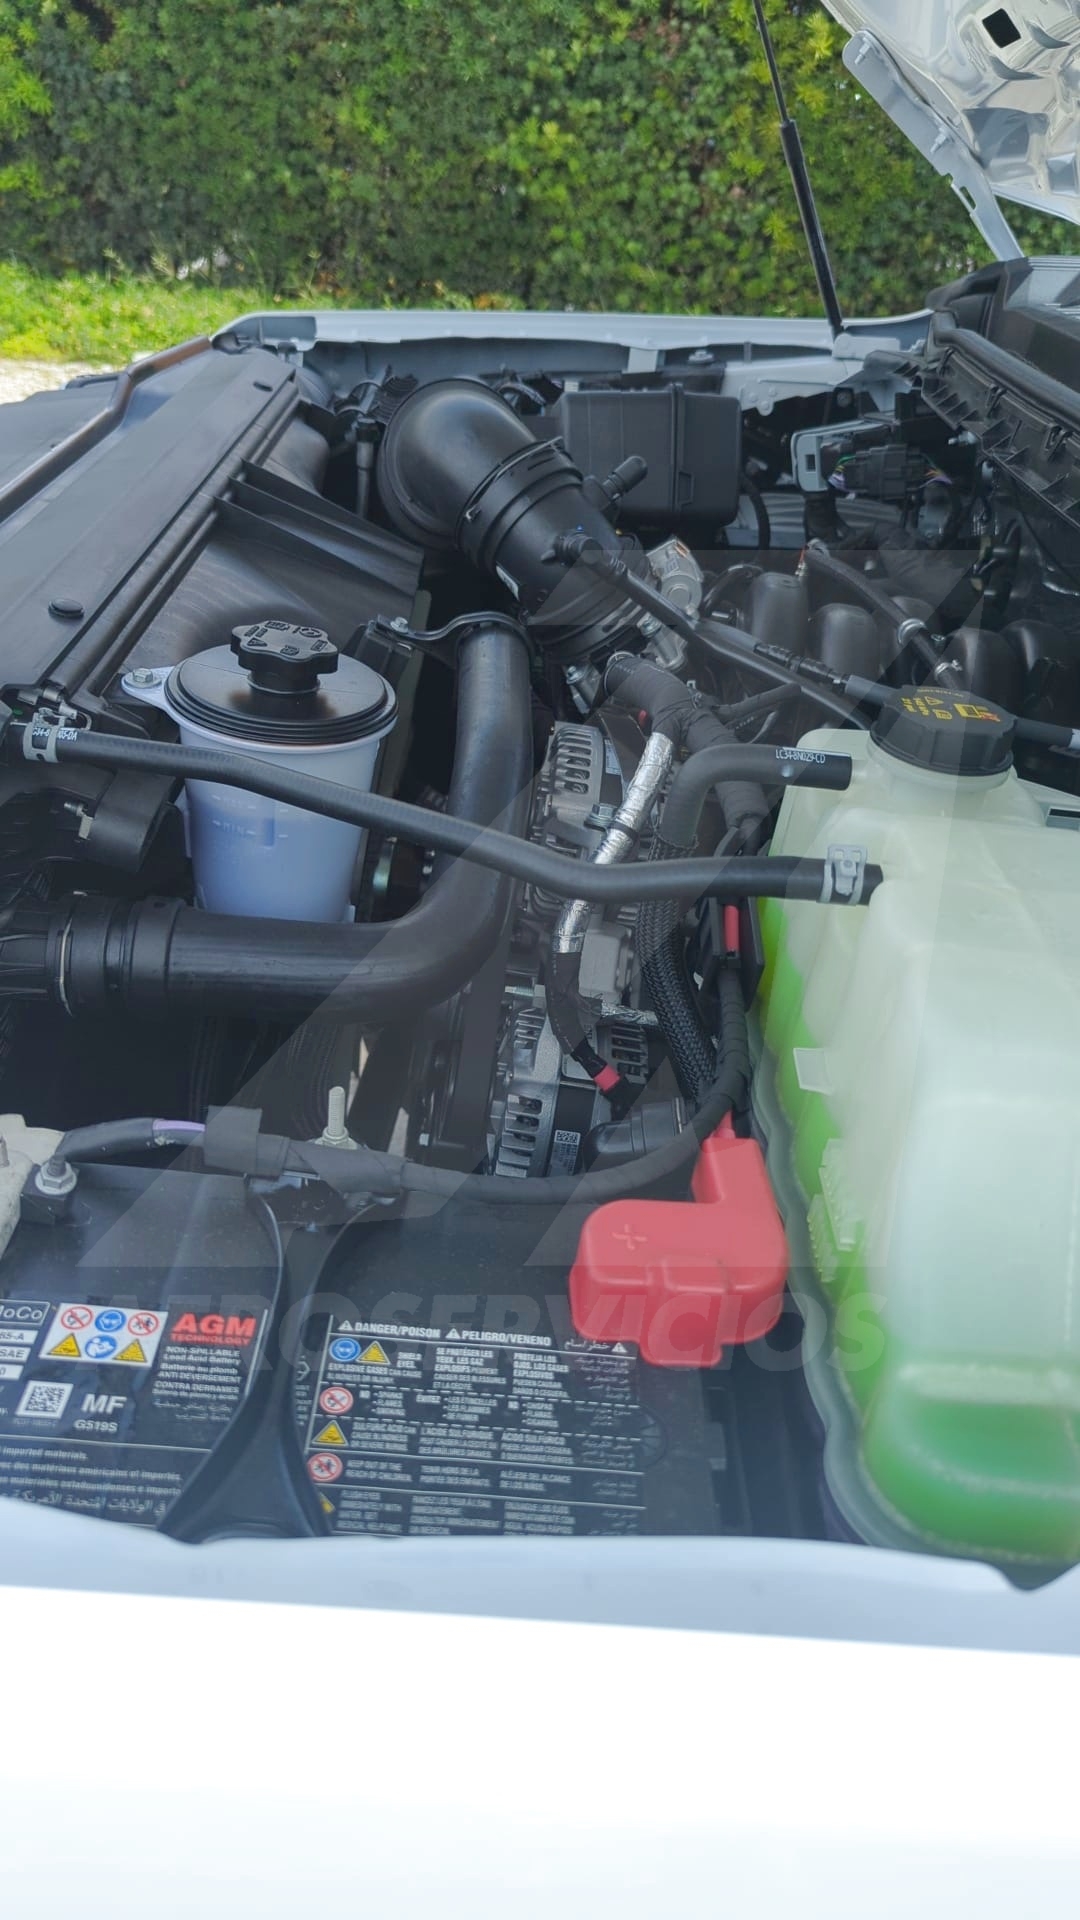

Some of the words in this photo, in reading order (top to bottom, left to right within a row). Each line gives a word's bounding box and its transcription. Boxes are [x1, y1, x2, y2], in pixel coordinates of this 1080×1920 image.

[172, 1312, 256, 1337] AGM
[354, 1322, 440, 1339] DANGER/POISON
[171, 1335, 251, 1346] TECHNOLOGY
[462, 1330, 552, 1346] PELIGRO/VENENO
[166, 1346, 240, 1357] NON-SPILLABLE
[82, 1394, 128, 1414] MF
